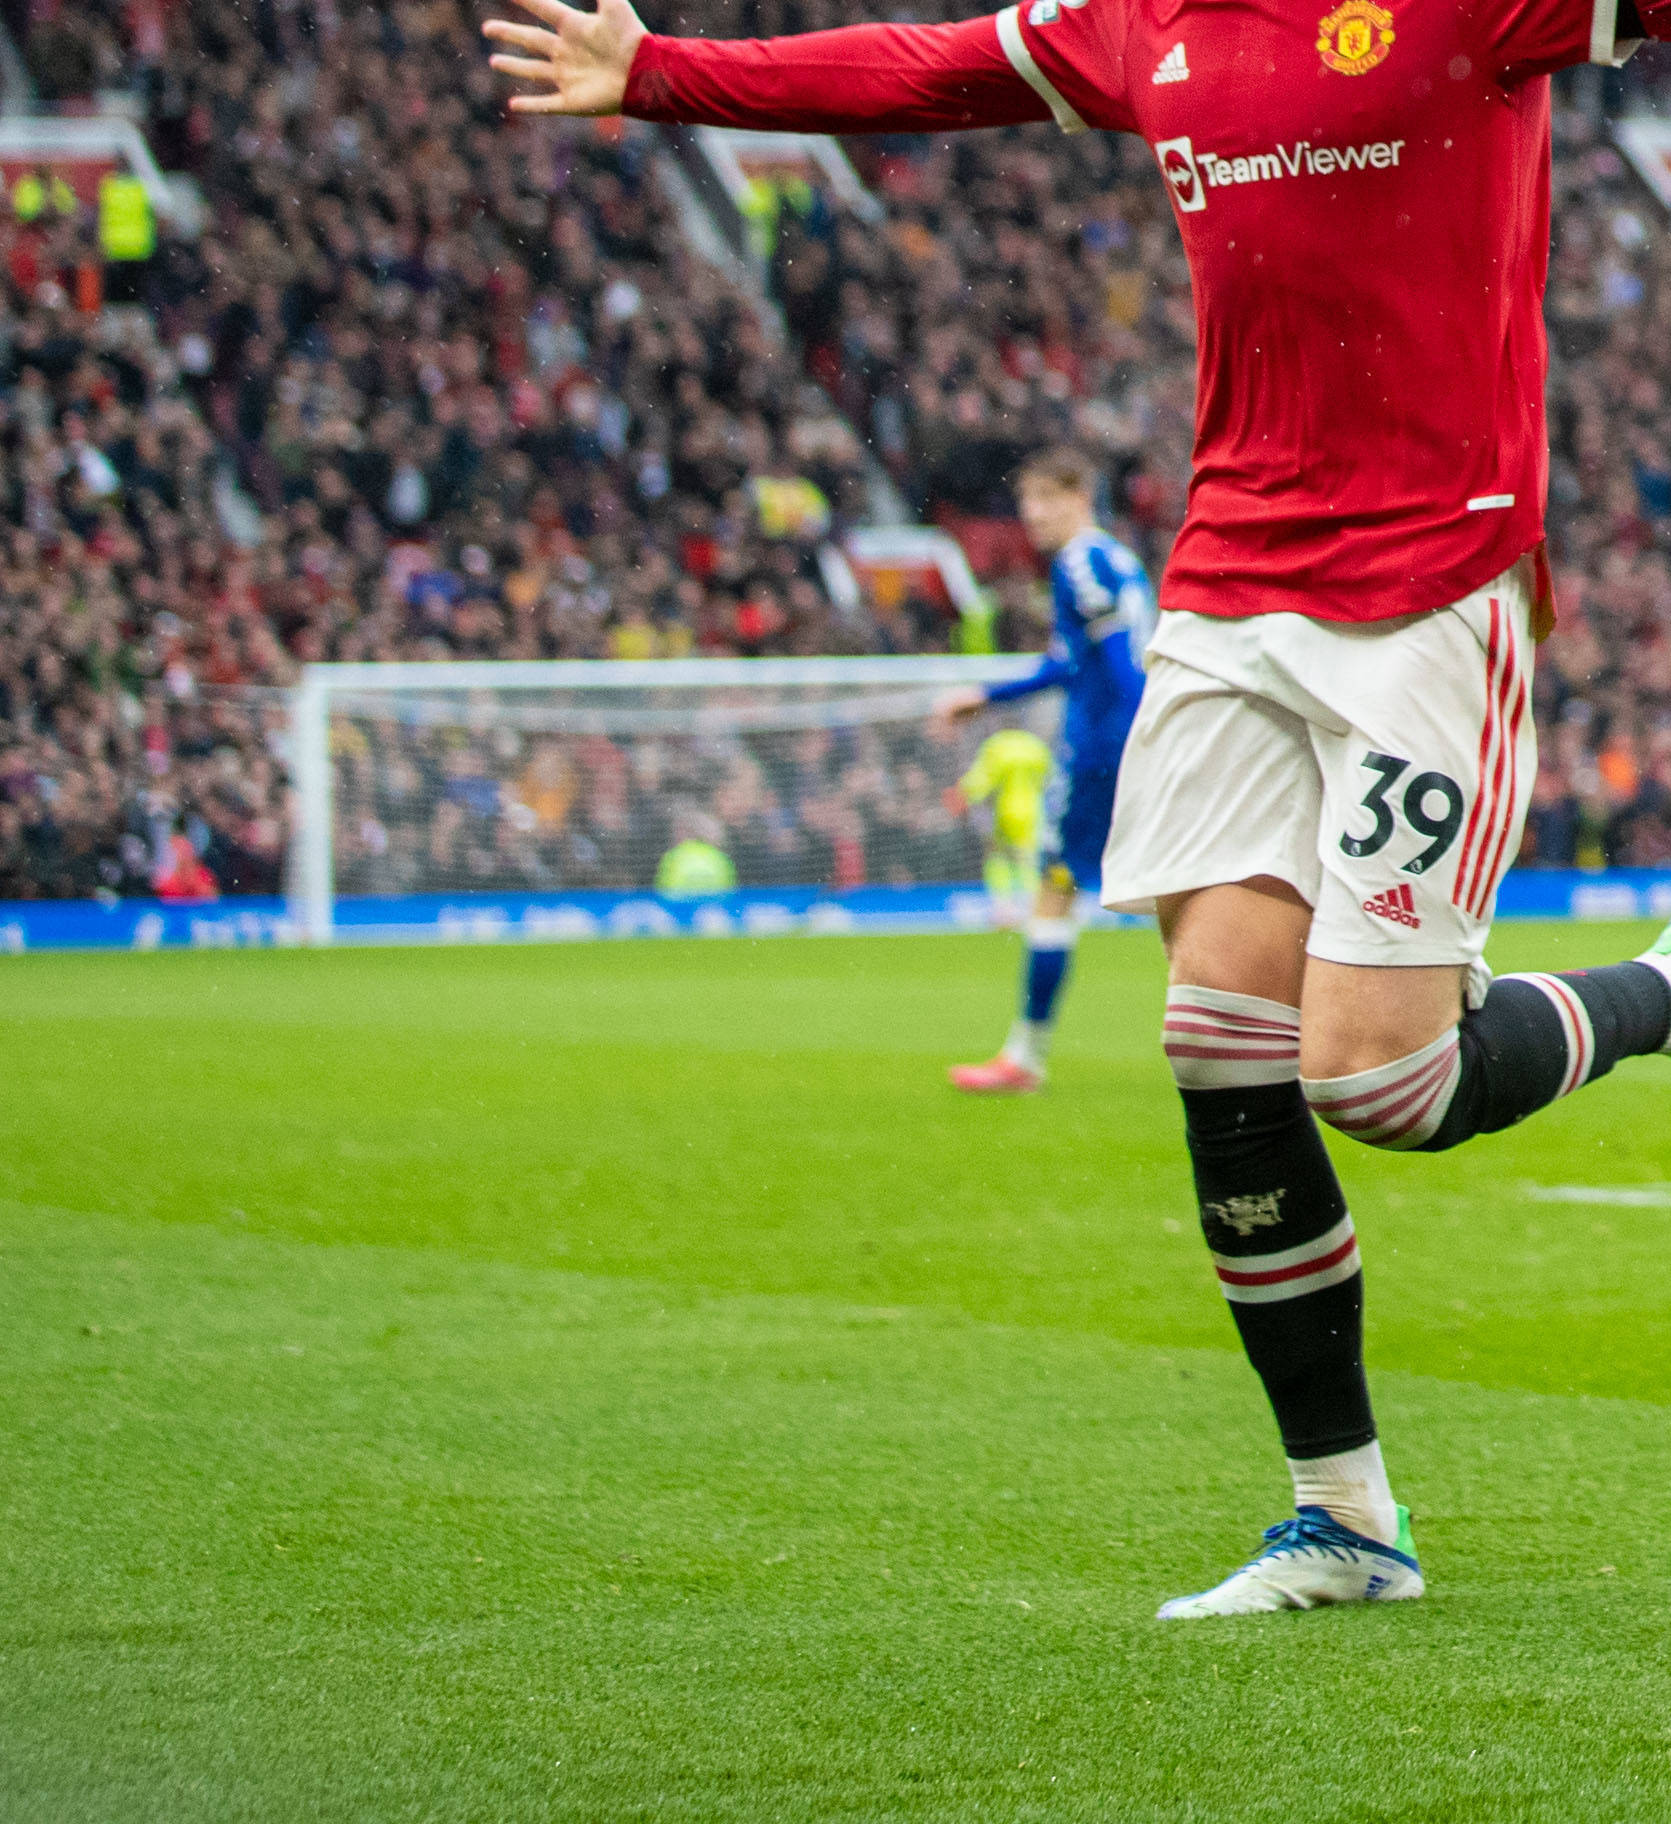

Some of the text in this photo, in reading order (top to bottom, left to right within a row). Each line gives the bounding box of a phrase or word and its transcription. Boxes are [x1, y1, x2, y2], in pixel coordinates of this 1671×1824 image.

[1195, 139, 1406, 188] TeamViewer
[1338, 750, 1465, 876] 39
[1362, 900, 1423, 930] adidas
